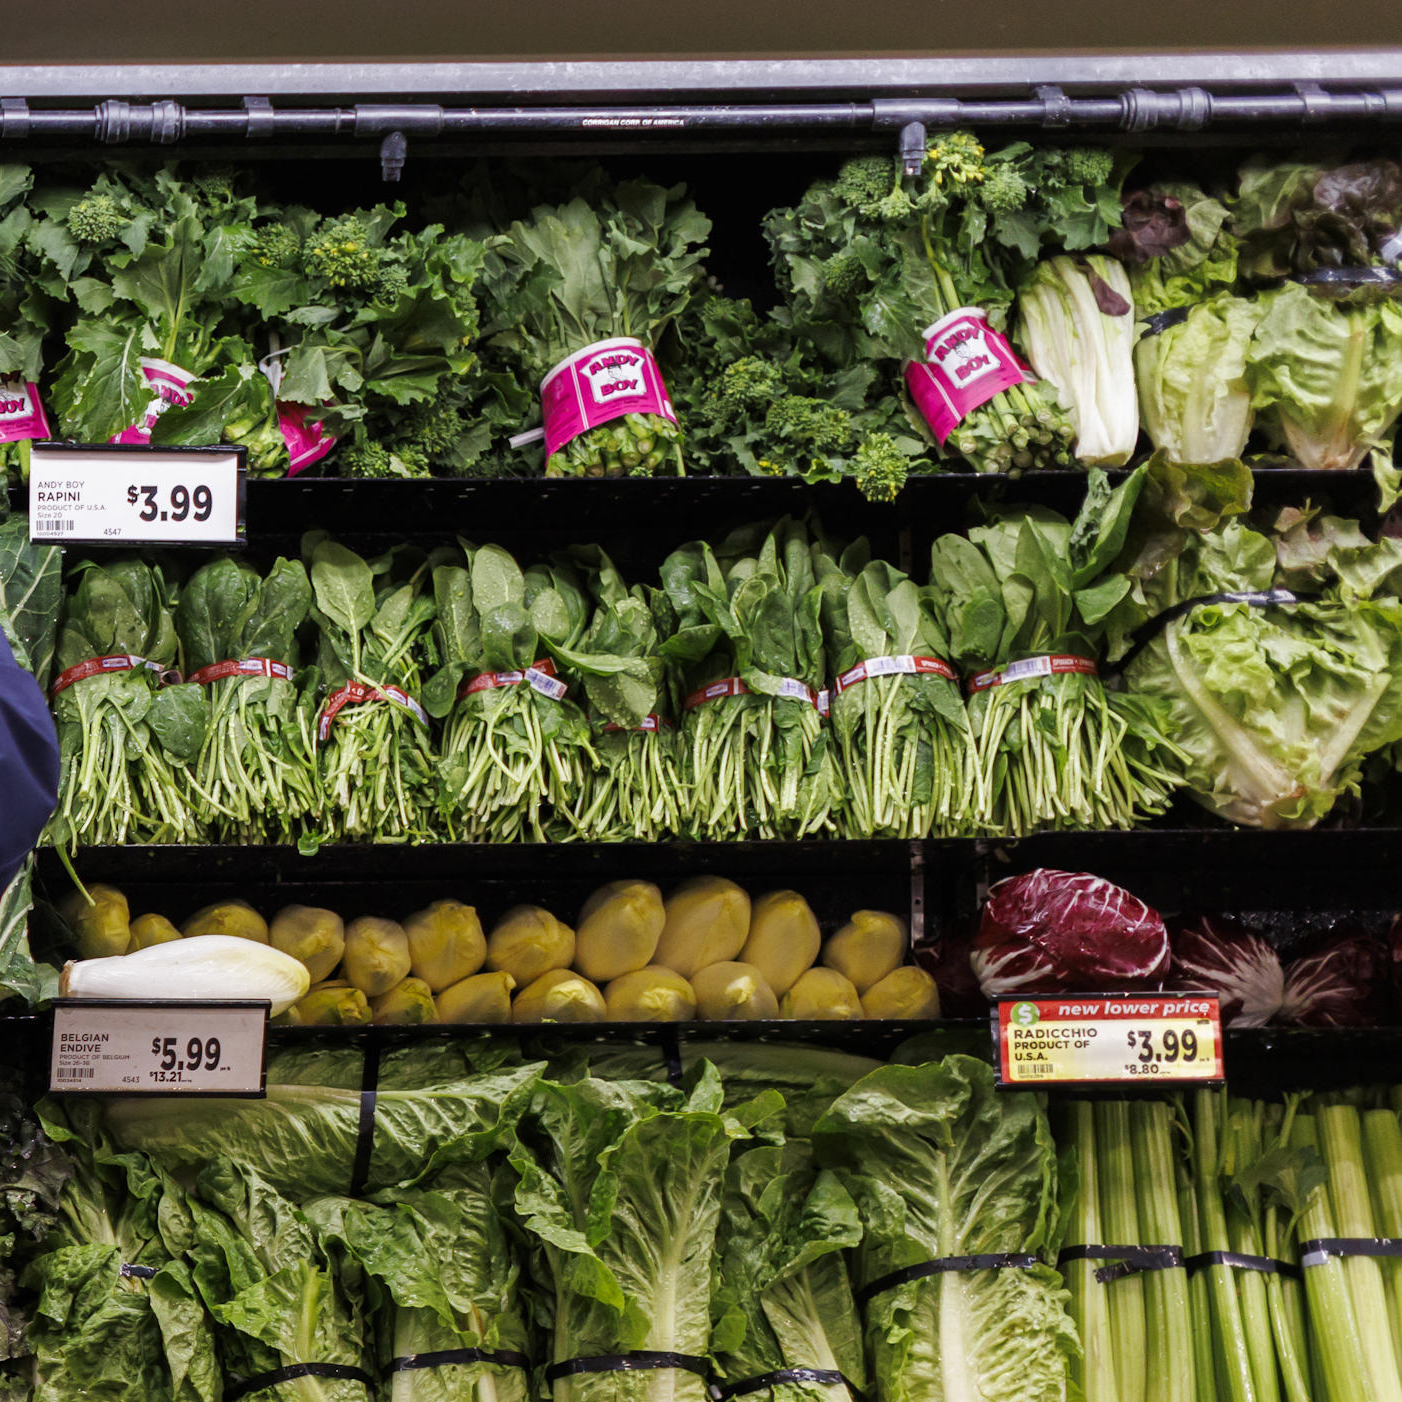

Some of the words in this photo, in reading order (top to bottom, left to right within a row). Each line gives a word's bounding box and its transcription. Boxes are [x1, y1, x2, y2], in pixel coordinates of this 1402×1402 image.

[934, 327, 981, 361] ANDY
[589, 354, 639, 376] ANDY
[600, 379, 638, 396] BOY
[37, 481, 63, 489] ANDY
[66, 480, 85, 488] BOY
[38, 492, 80, 502] RAPINI
[126, 484, 213, 522] $3.99
[103, 528, 122, 536] 4547
[1058, 1004, 1101, 1016] new
[1104, 1001, 1159, 1016] lower
[1163, 1000, 1210, 1016] price
[61, 1033, 109, 1042] BELGIAN
[1014, 1028, 1097, 1039] RADICCHIO
[61, 1044, 101, 1053] ENDIVE
[1014, 1041, 1068, 1050] PRODUCT
[1074, 1040, 1090, 1049] OF
[1127, 1029, 1198, 1063] $3.99
[151, 1036, 221, 1071] $5.99
[1015, 1052, 1048, 1061] U.S.A.
[149, 1071, 182, 1082] $13.21
